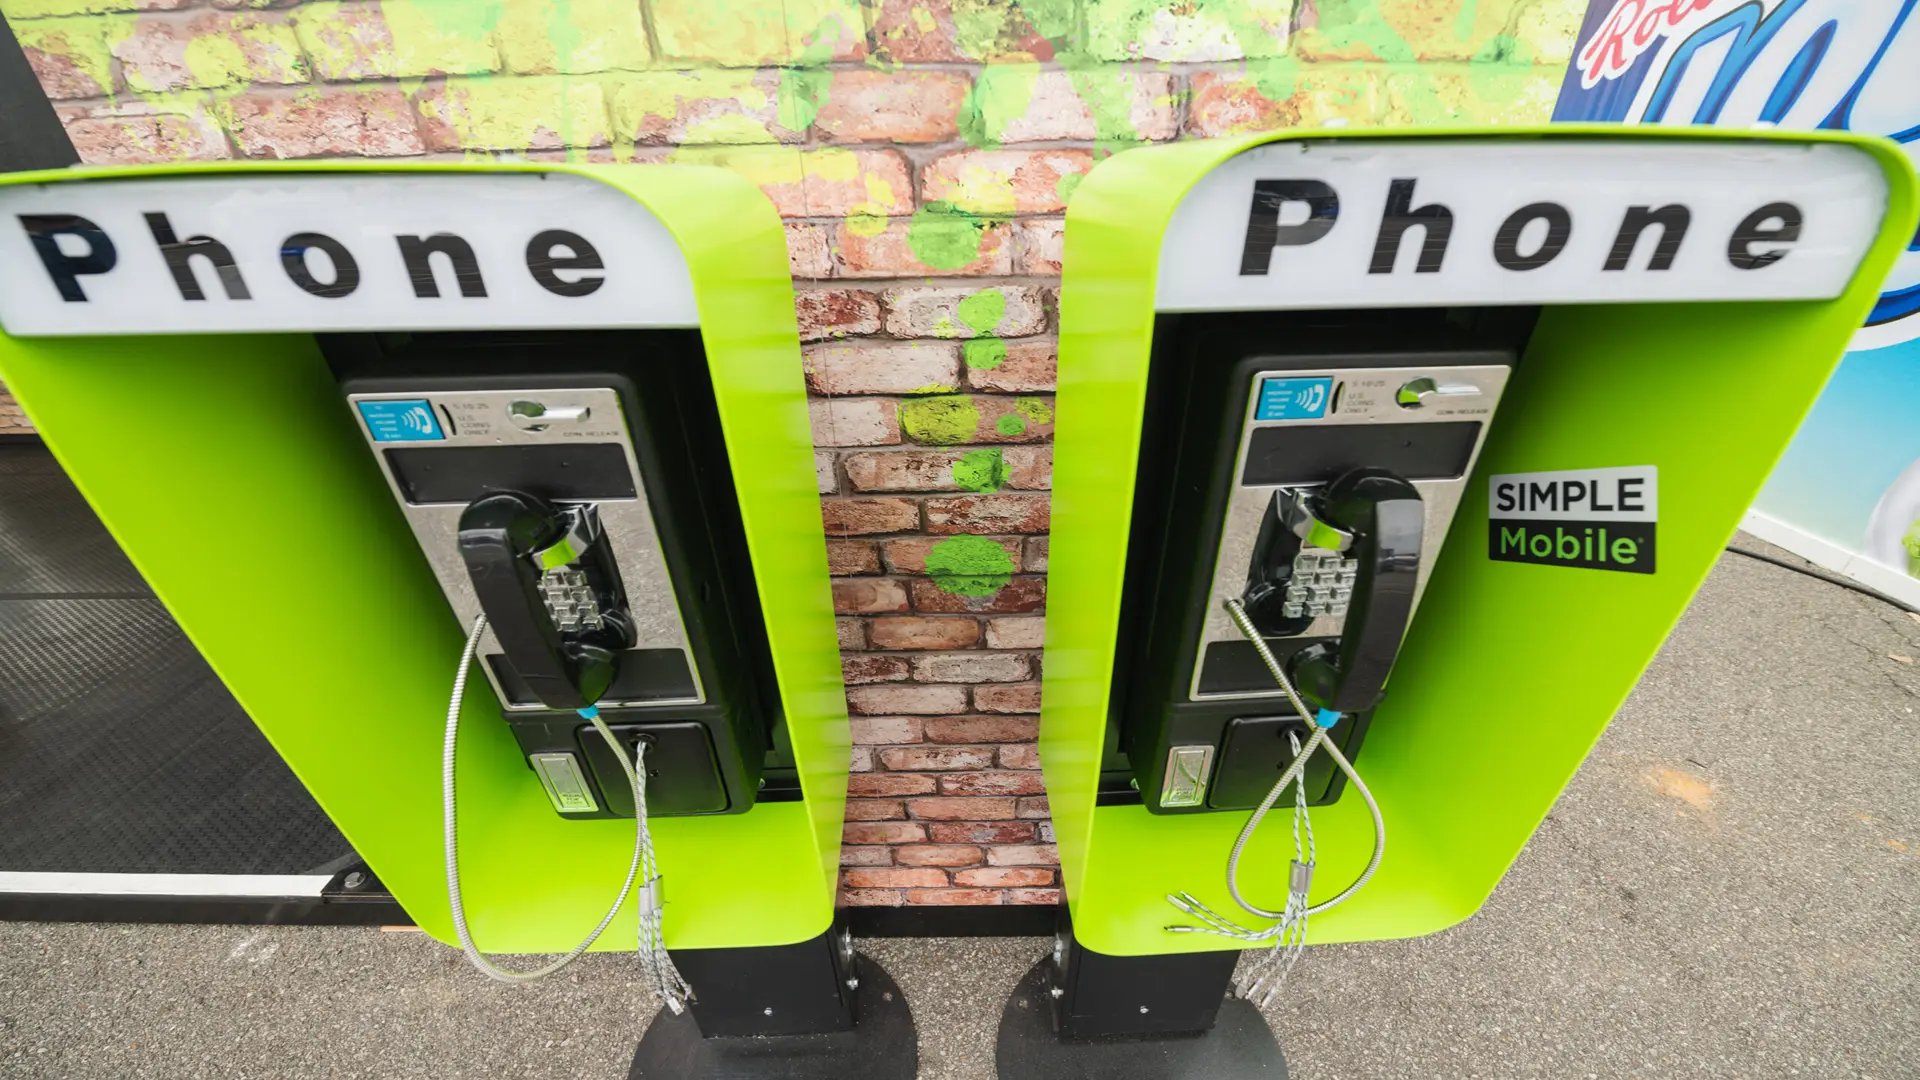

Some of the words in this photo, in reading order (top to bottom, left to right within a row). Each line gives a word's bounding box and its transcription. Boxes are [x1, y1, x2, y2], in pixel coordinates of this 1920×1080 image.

[16, 211, 606, 302] Phone
[1238, 178, 1804, 276] Phone
[1496, 478, 1645, 512] SIMPLE
[1501, 526, 1638, 564] Mobile
